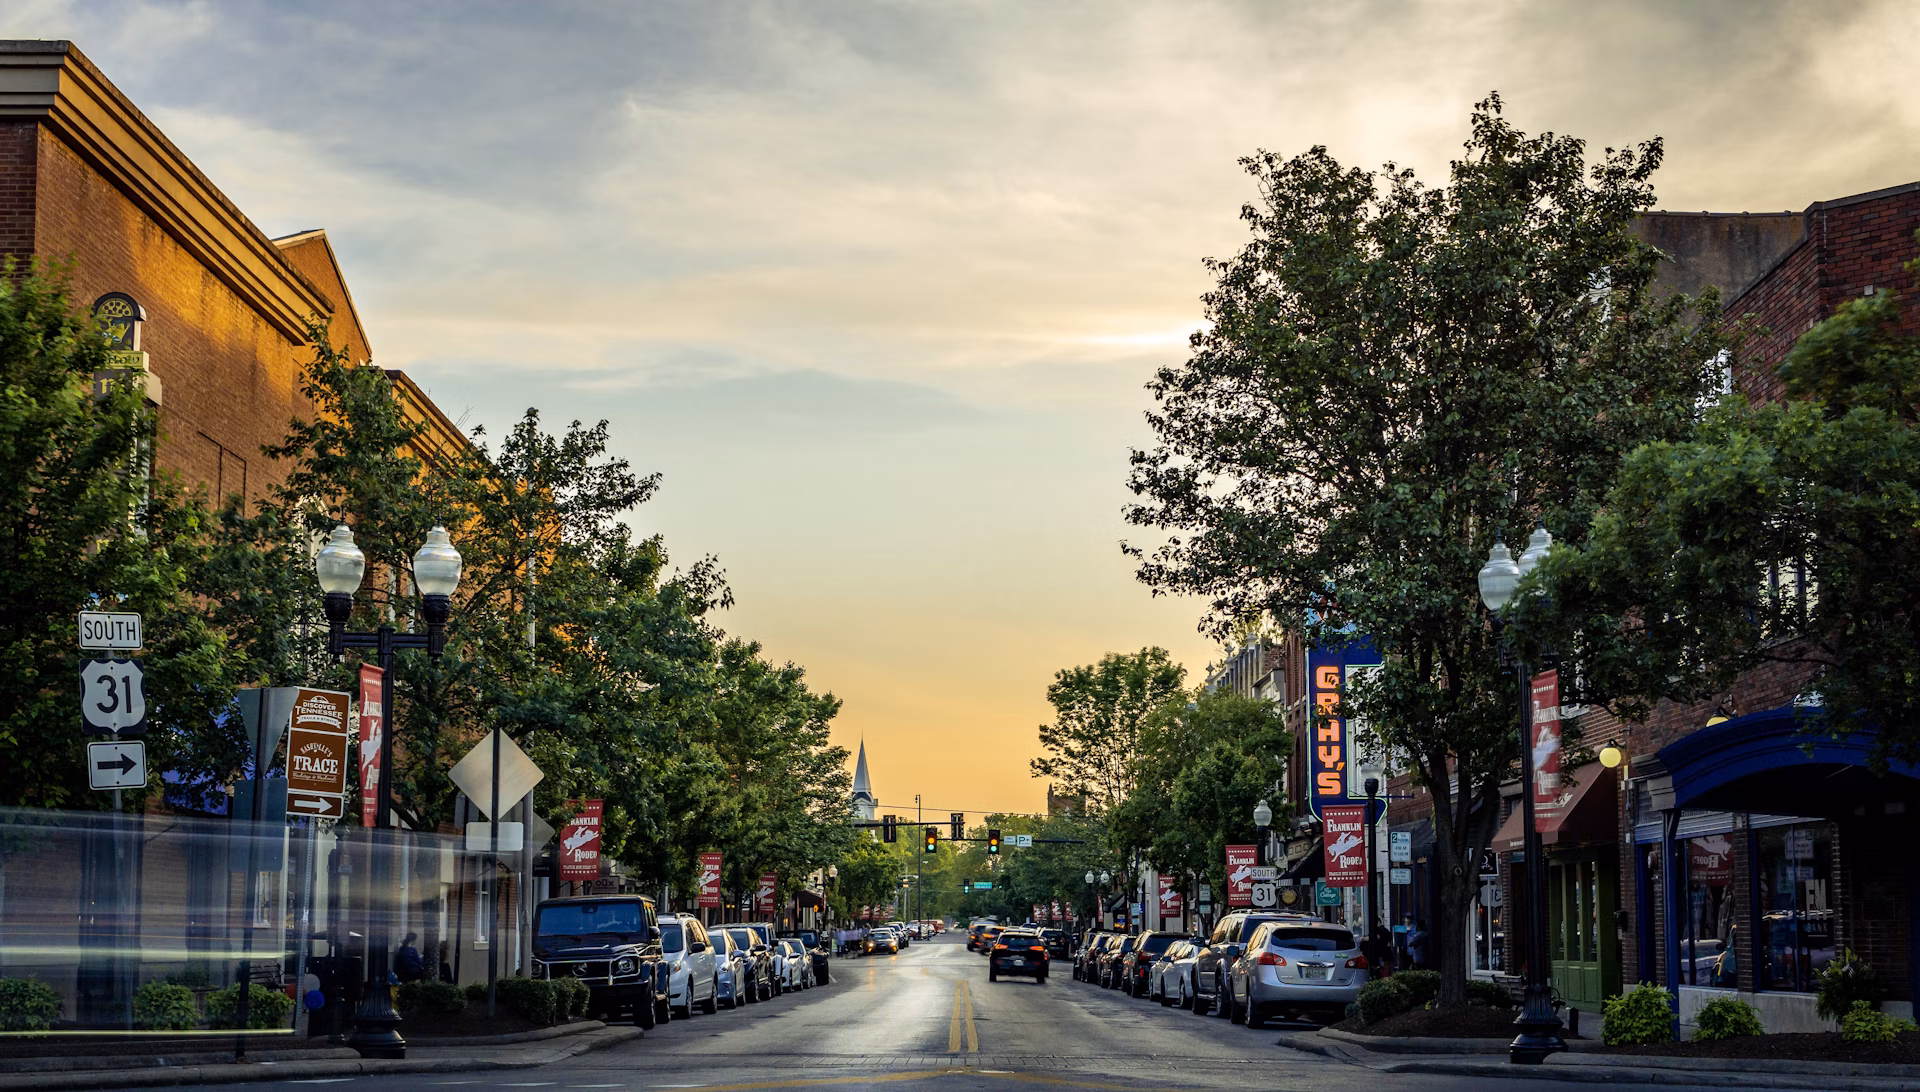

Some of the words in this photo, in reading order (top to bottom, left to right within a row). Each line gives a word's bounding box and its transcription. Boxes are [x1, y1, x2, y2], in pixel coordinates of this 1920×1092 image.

[84, 620, 136, 641] SOUTH
[96, 674, 132, 714] 31
[295, 705, 343, 720] TENNESSEE
[303, 702, 336, 711] DISCOVER
[1316, 665, 1345, 795] GRAY'S
[293, 755, 338, 774] TRACE
[570, 817, 599, 826] RANKLIN
[1327, 819, 1362, 833] FRANKLIN
[574, 848, 598, 862] RODEO
[1229, 855, 1255, 866] FRANKLIN
[1340, 854, 1363, 869] RODEO
[1252, 869, 1275, 877] SOUTH
[1238, 881, 1252, 892] RODE
[1256, 887, 1271, 901] 31
[1807, 922, 1829, 934] BANK
